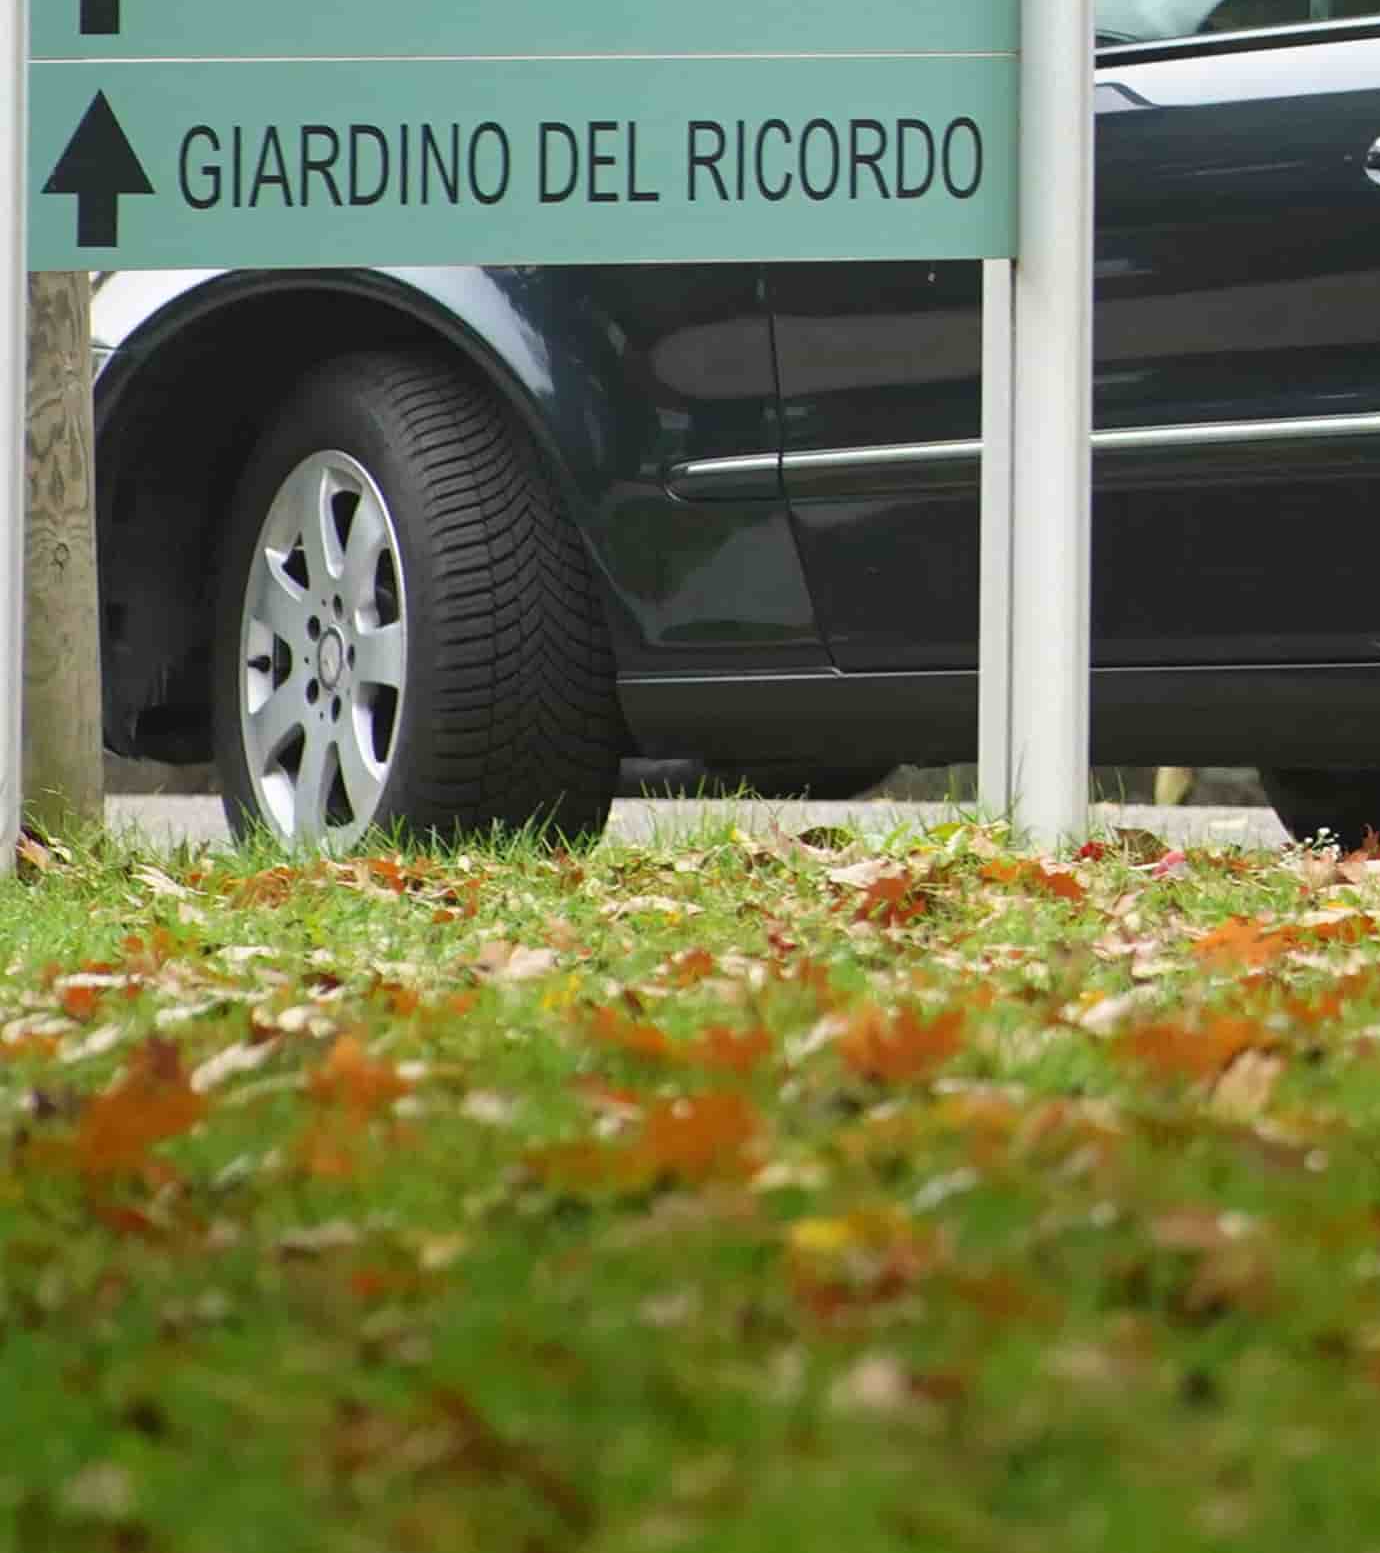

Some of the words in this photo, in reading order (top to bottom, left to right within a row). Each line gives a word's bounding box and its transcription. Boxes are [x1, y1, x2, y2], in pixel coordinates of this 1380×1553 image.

[177, 120, 512, 211] GIARDINO
[538, 119, 661, 205] DEL
[686, 115, 984, 203] RICORDO
